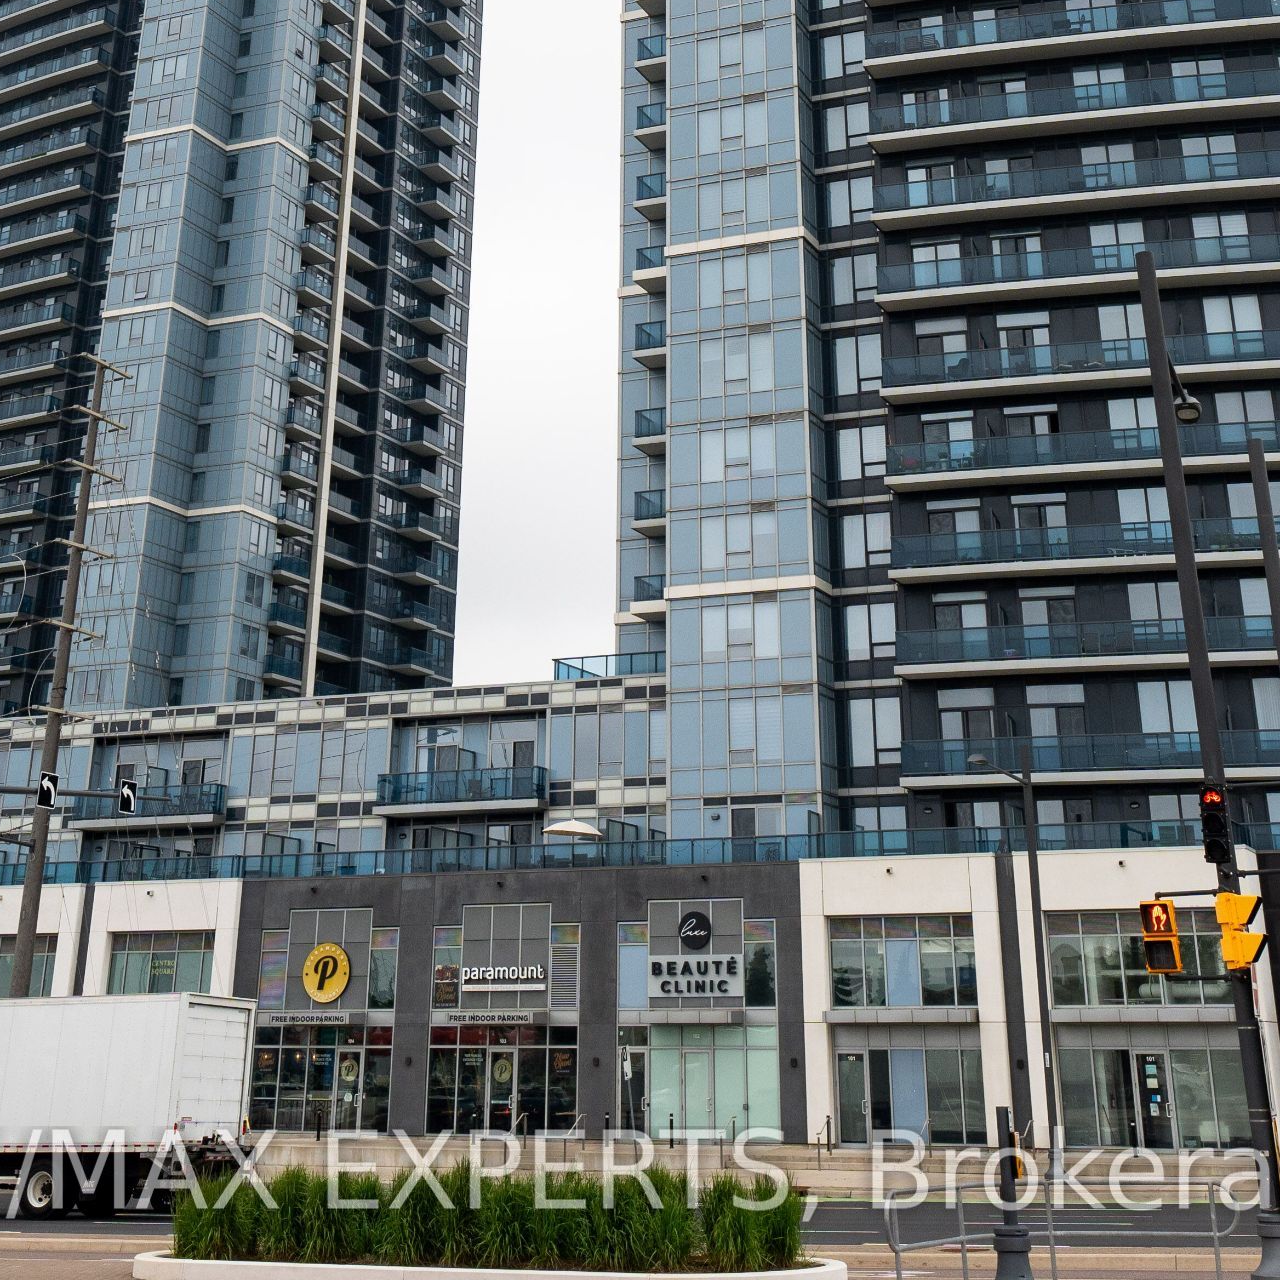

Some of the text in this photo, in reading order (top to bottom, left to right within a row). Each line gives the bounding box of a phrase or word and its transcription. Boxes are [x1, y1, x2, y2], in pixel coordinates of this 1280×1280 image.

[651, 956, 738, 976] BEAUTÉ
[462, 964, 544, 984] paramount
[660, 980, 729, 994] CLINIC
[271, 1015, 345, 1023] FREE INDOOR PARKING
[497, 1014, 529, 1022] PARKING
